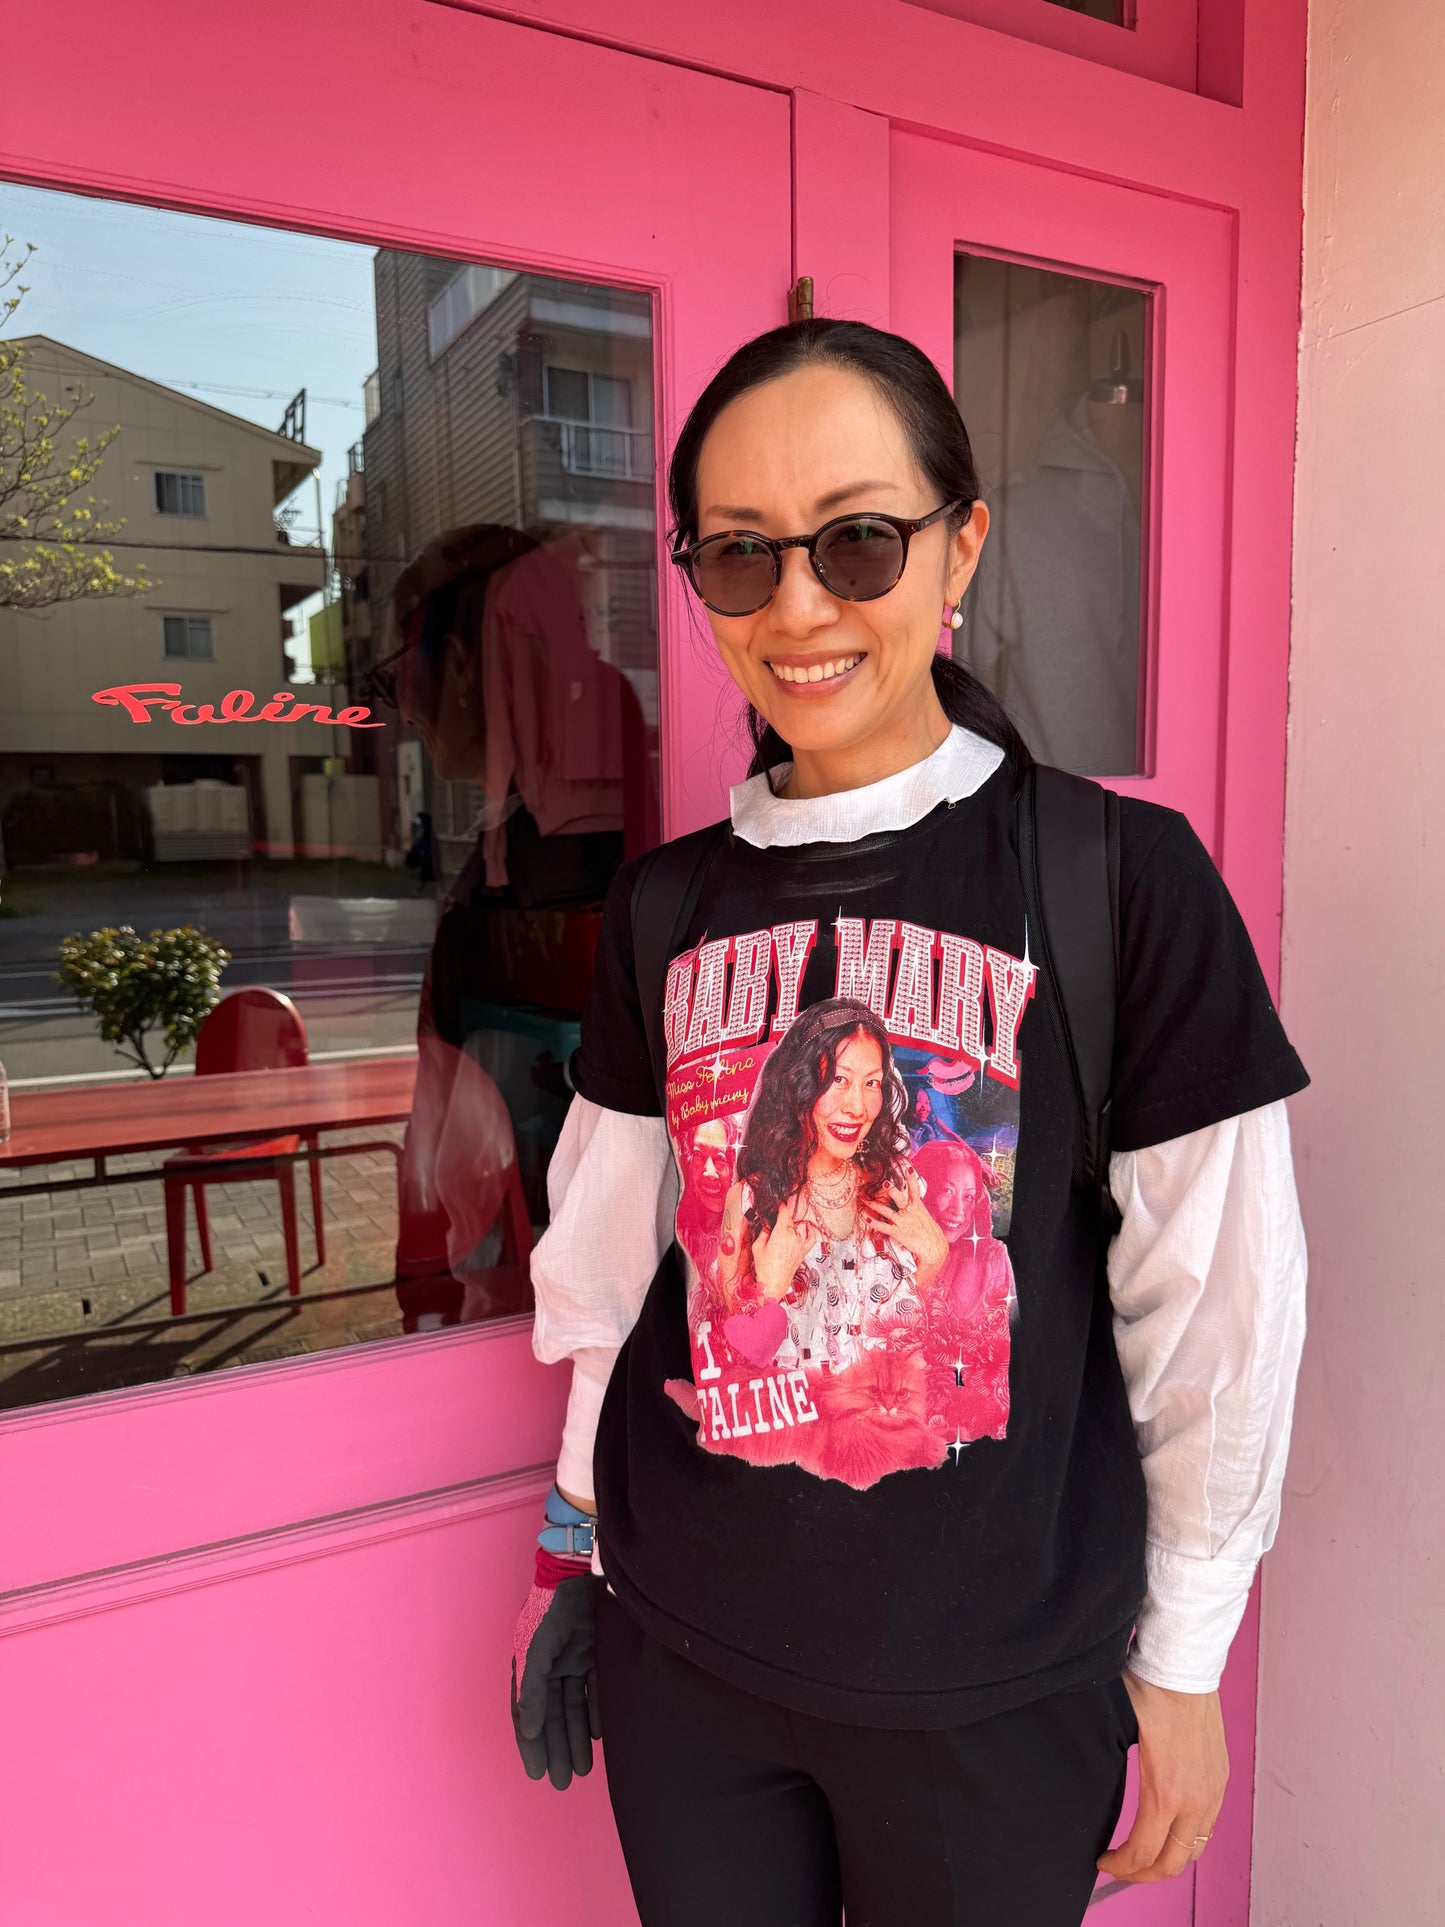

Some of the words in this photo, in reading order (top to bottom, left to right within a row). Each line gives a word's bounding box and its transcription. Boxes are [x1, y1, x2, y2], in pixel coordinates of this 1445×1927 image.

[92, 683, 386, 728] Faline
[664, 919, 819, 1073] BABY
[835, 917, 1037, 1091] MARY
[667, 1079, 695, 1101] Miss
[671, 1109, 680, 1130] by
